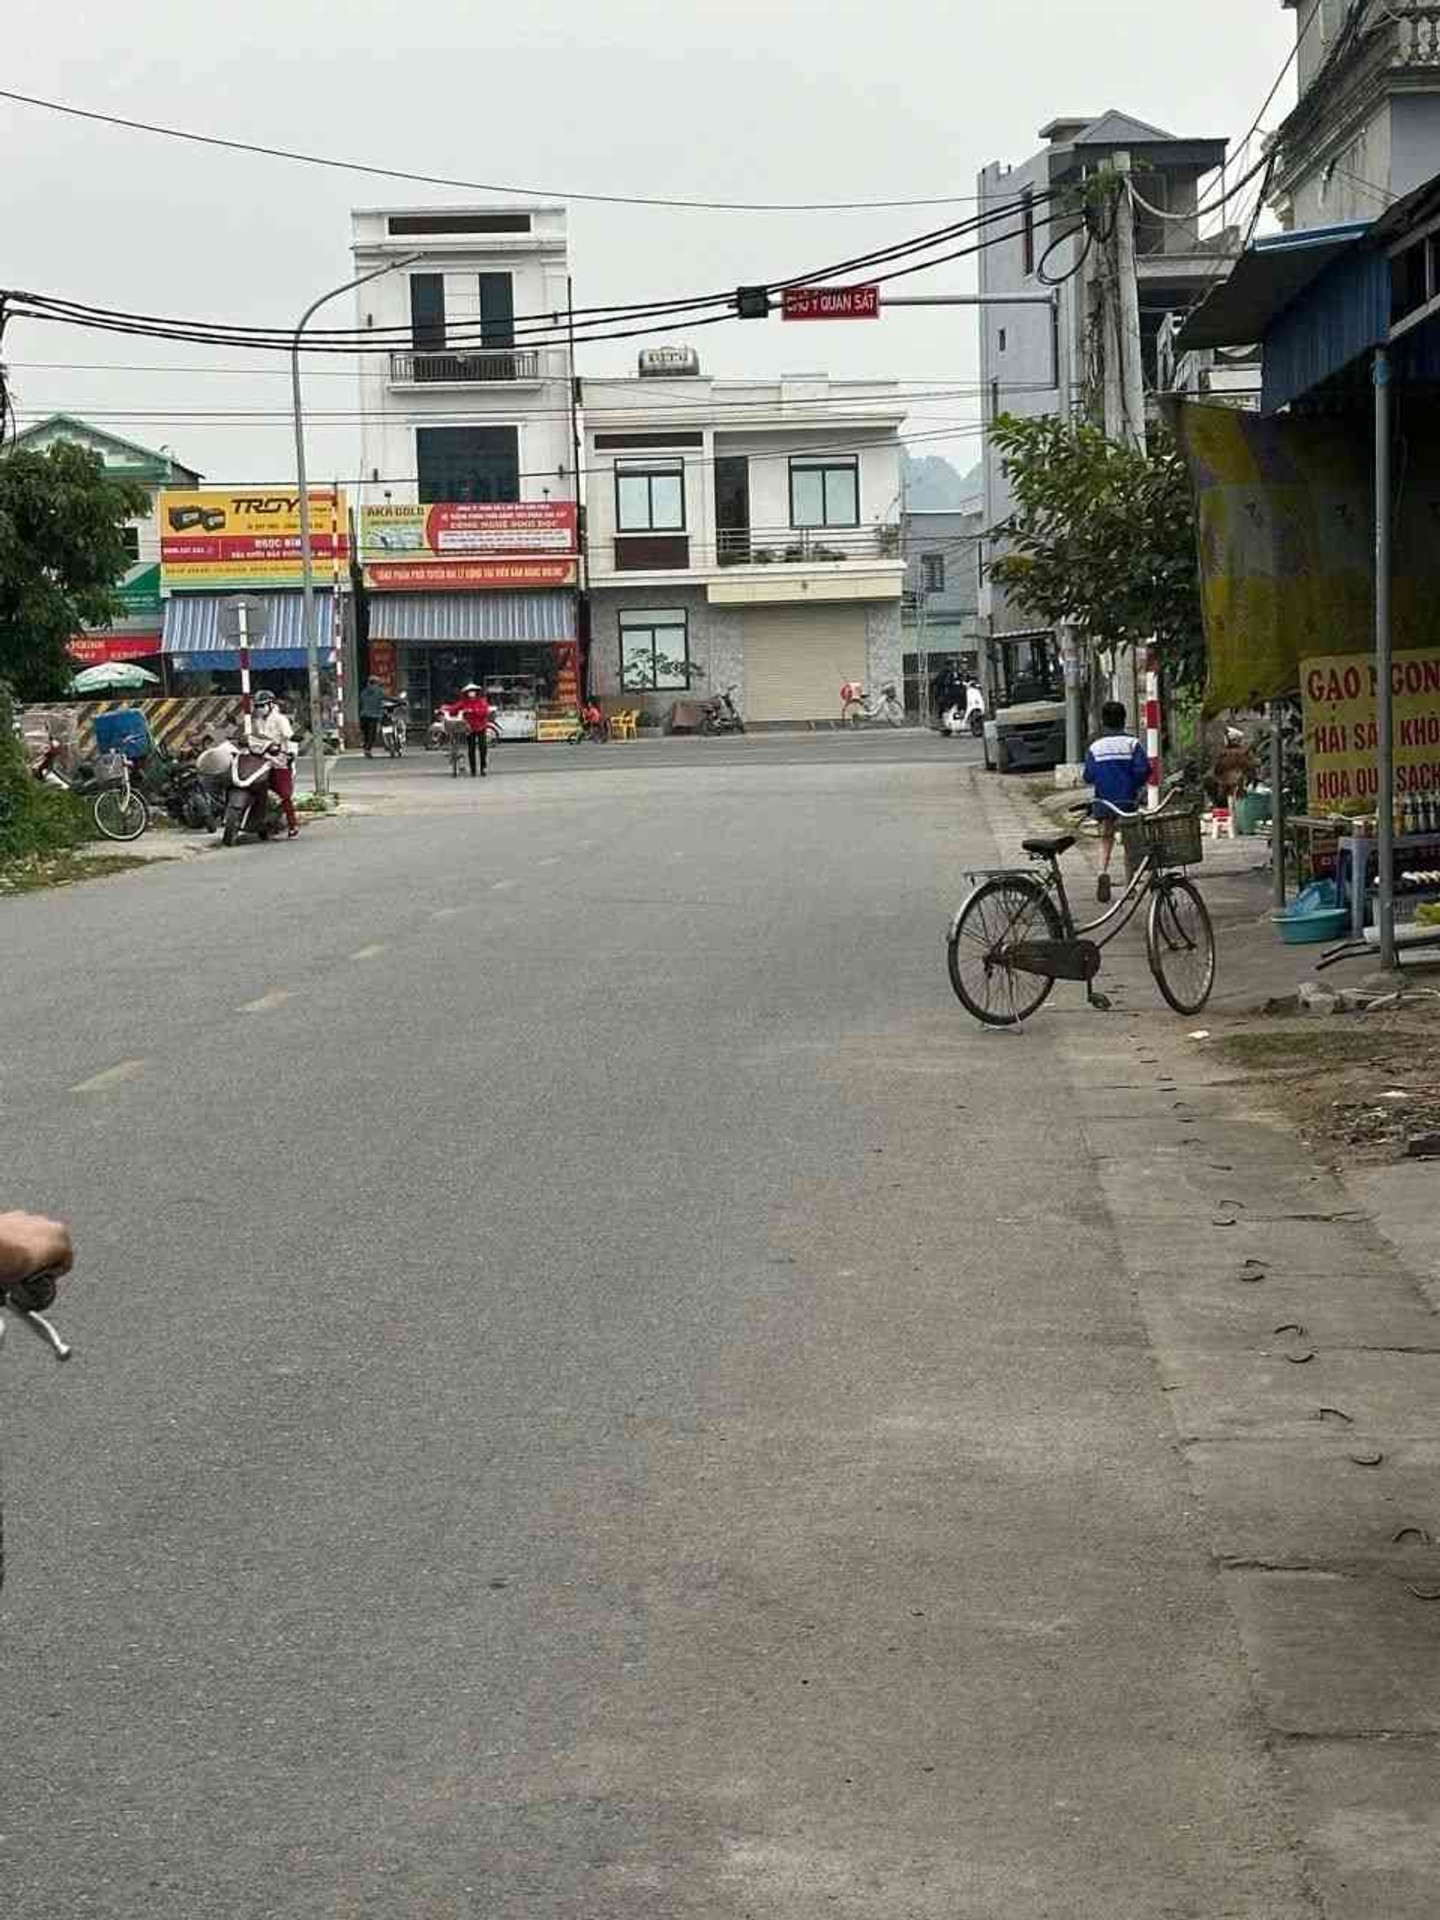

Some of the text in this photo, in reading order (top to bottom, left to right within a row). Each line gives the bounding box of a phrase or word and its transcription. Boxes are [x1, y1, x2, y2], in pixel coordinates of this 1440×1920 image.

[820, 294, 851, 311] QUAN
[854, 289, 874, 310] SÁT
[231, 498, 301, 514] TROY
[1307, 666, 1361, 709] GẠO
[1316, 769, 1351, 799] HOA
